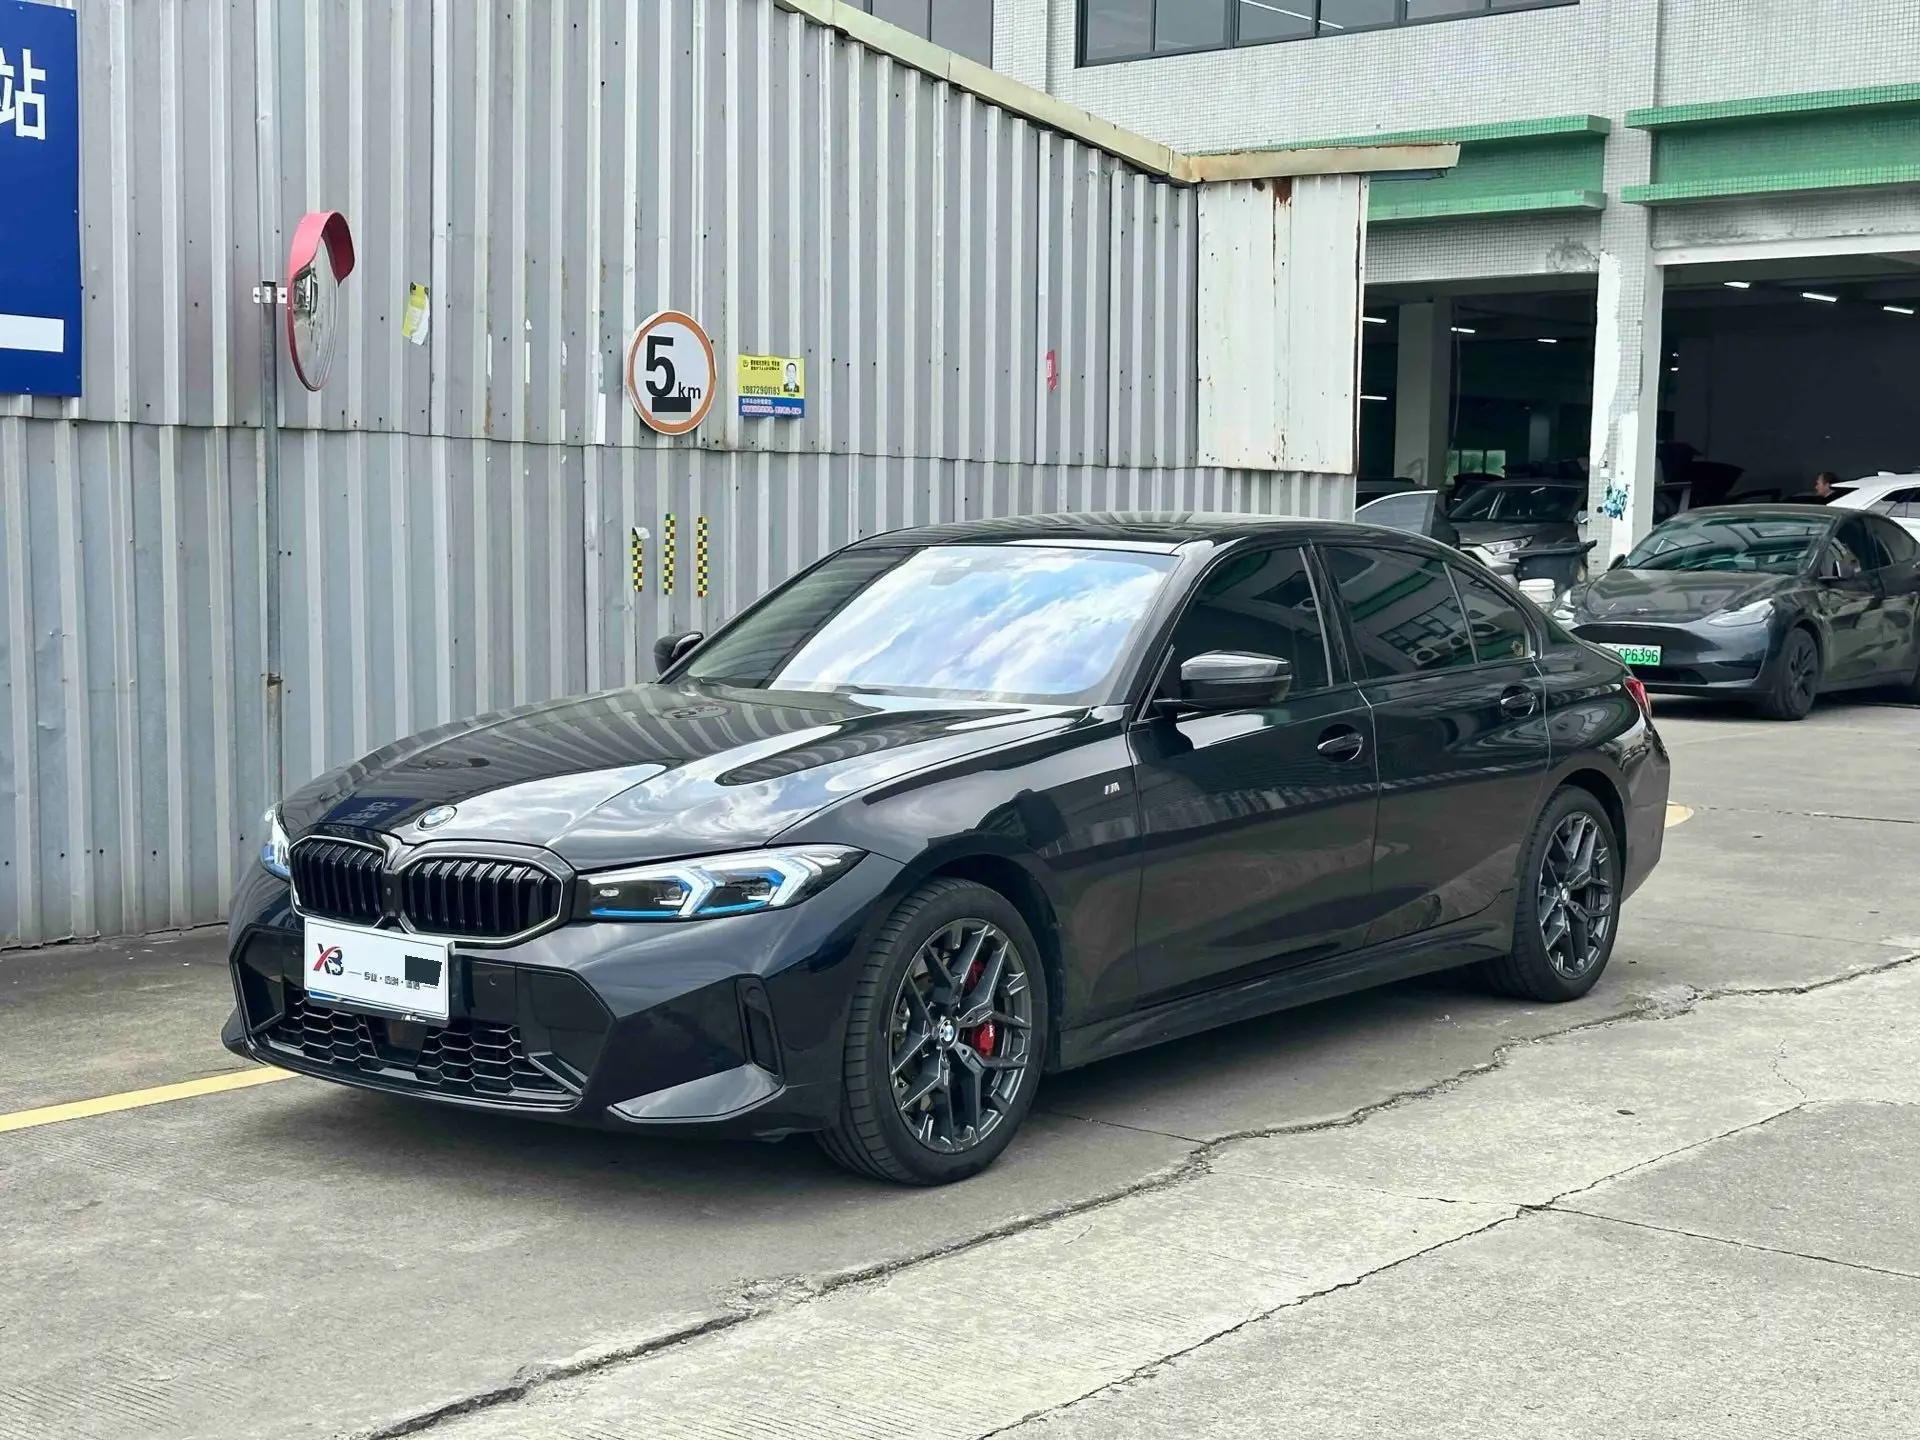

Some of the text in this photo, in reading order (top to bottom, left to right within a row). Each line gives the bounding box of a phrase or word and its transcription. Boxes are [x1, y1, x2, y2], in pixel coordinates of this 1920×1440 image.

[0, 47, 47, 141] 站
[646, 335, 701, 400] 5 km
